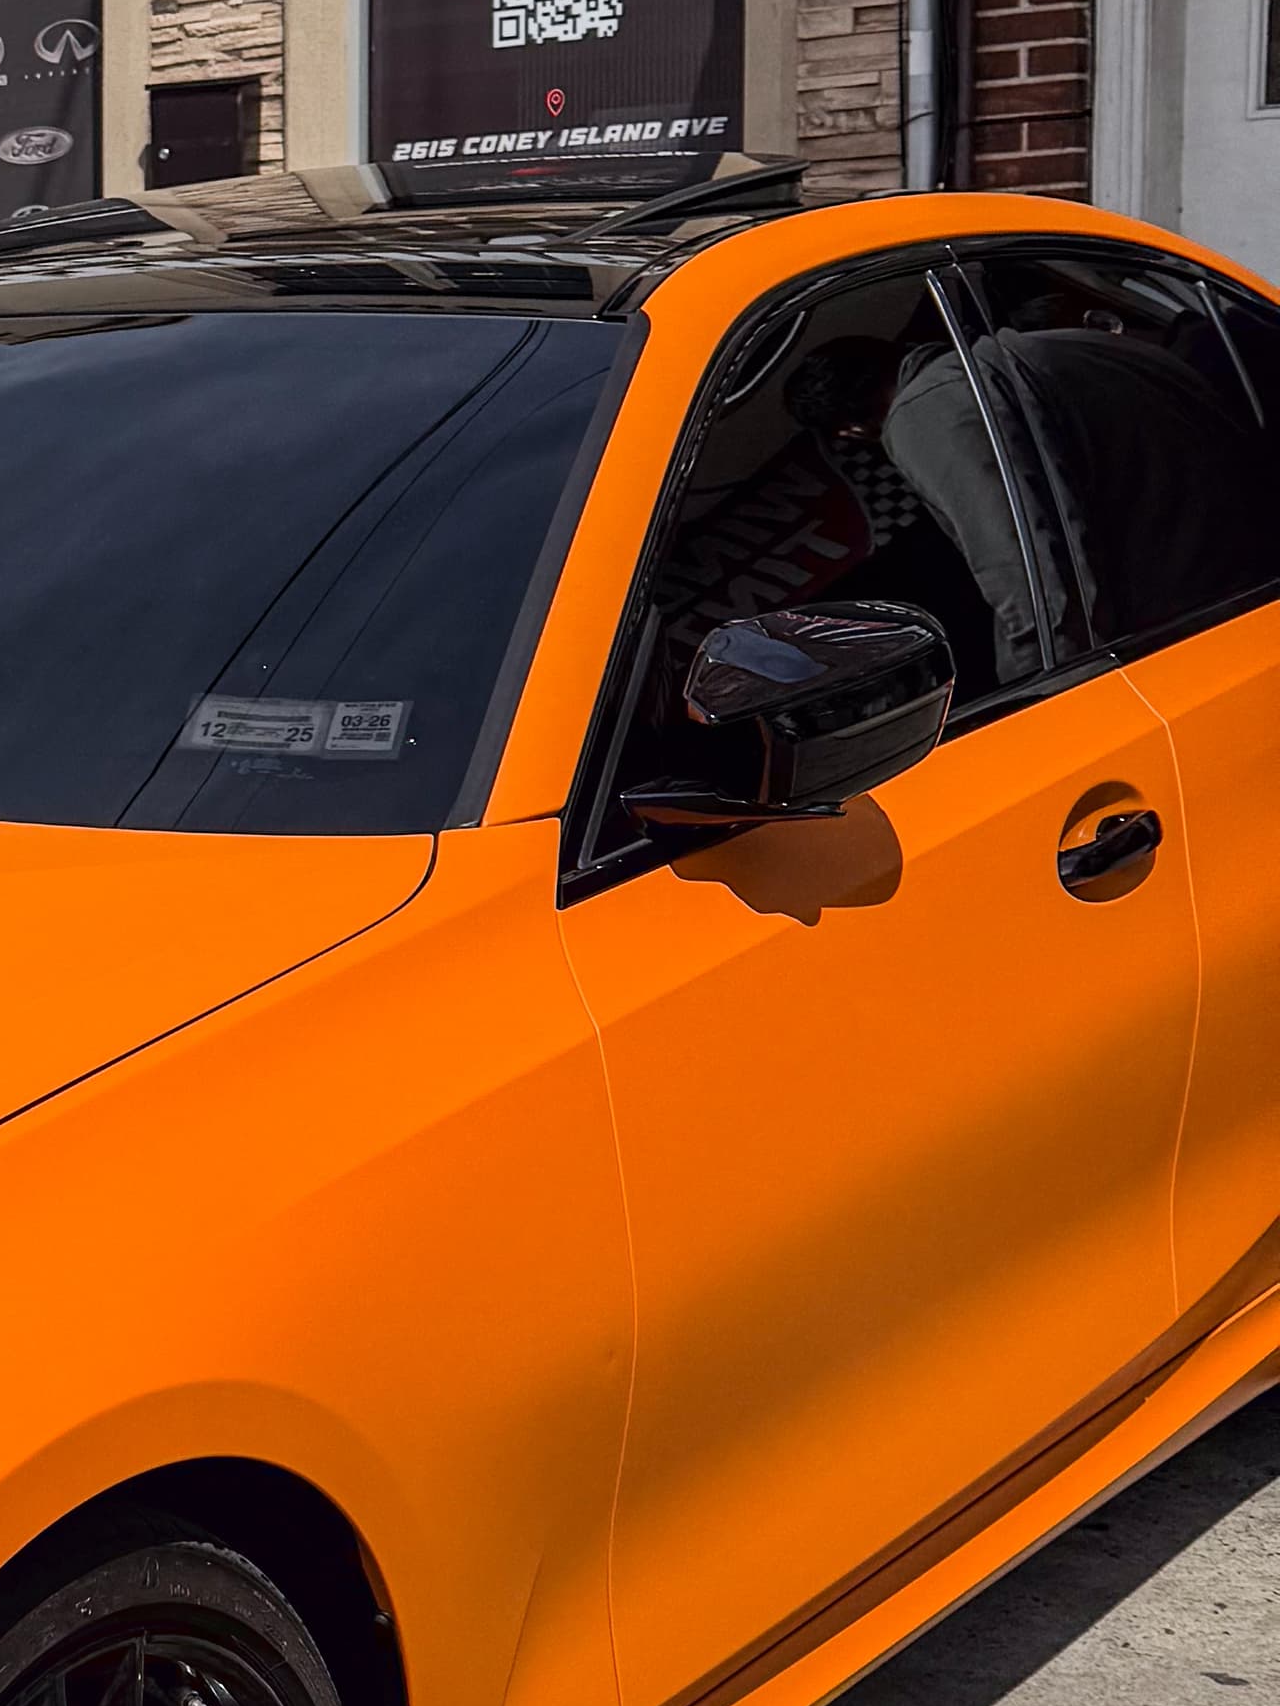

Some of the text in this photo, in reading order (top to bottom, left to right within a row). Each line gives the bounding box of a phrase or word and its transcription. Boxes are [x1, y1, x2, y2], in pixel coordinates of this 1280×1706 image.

[392, 116, 728, 162] 2615 CONEY ISLAND AVE
